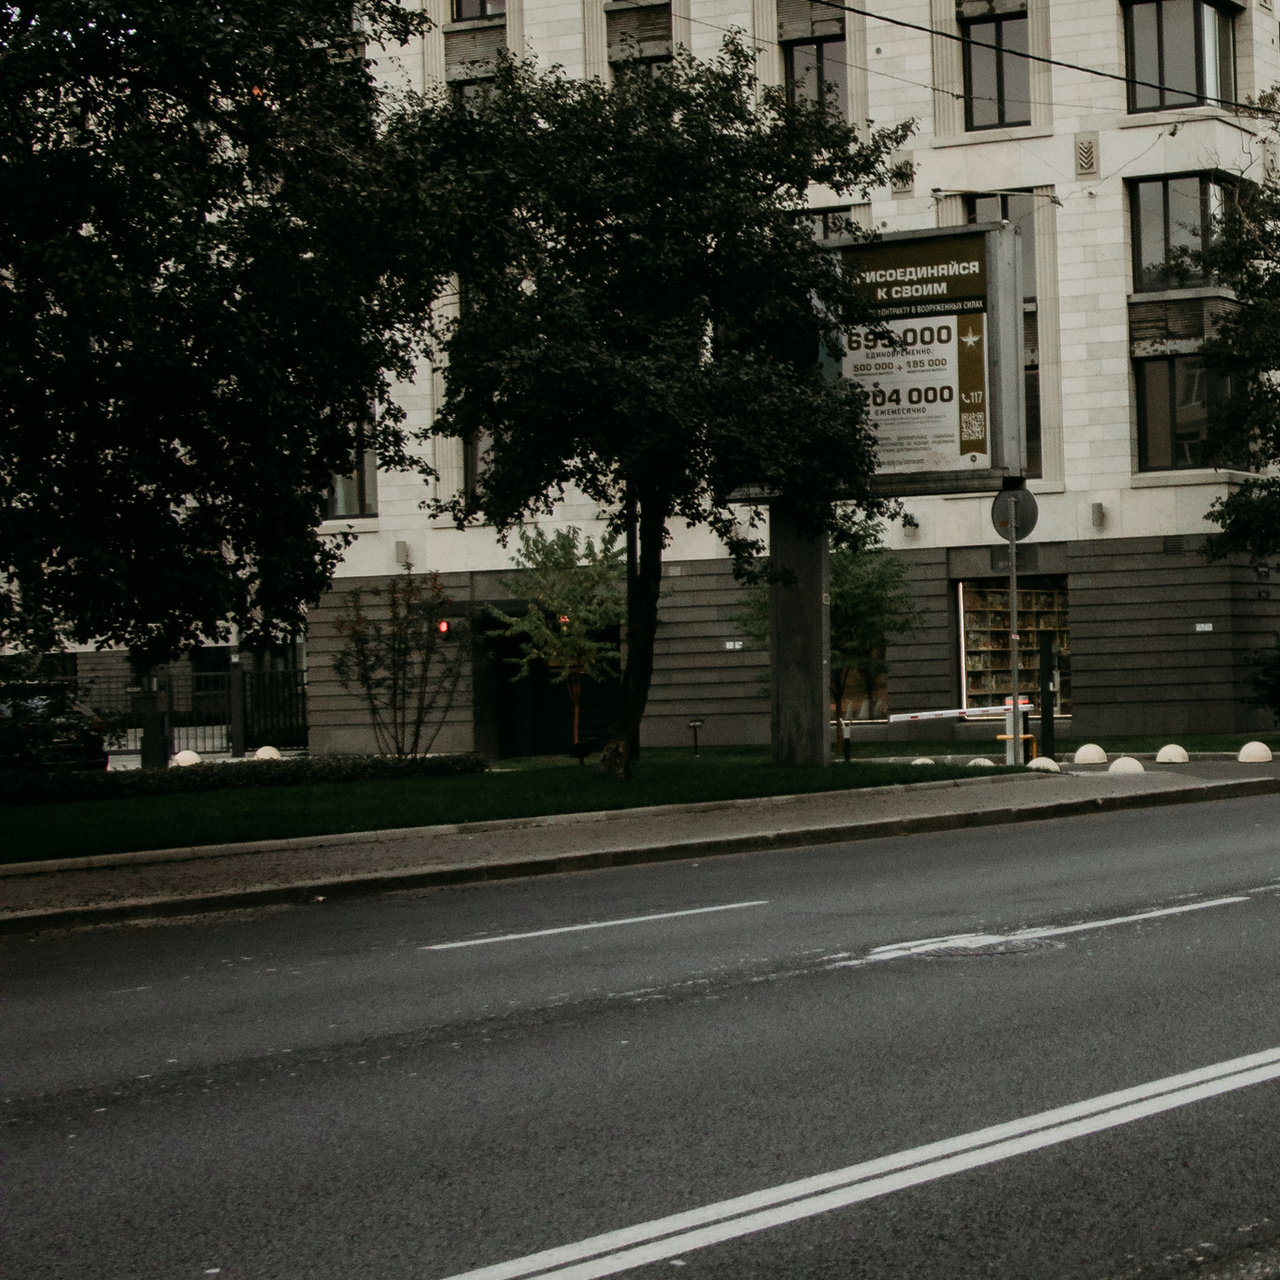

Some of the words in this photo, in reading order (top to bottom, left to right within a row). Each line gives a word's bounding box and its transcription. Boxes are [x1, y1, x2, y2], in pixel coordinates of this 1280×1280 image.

[853, 260, 980, 285] ИСОЕДИНЯЙСЯ
[877, 287, 889, 300] К
[891, 282, 948, 299] СВОИМ
[911, 304, 916, 314] В
[963, 300, 984, 310] СИЛАХ
[903, 325, 952, 346] 000
[853, 363, 872, 373] 500
[875, 361, 894, 372] 000
[928, 357, 948, 368] 000
[908, 385, 954, 404] 000
[970, 391, 983, 404] 117
[875, 406, 927, 417] ЕЖЕМЕСЯЧНО
